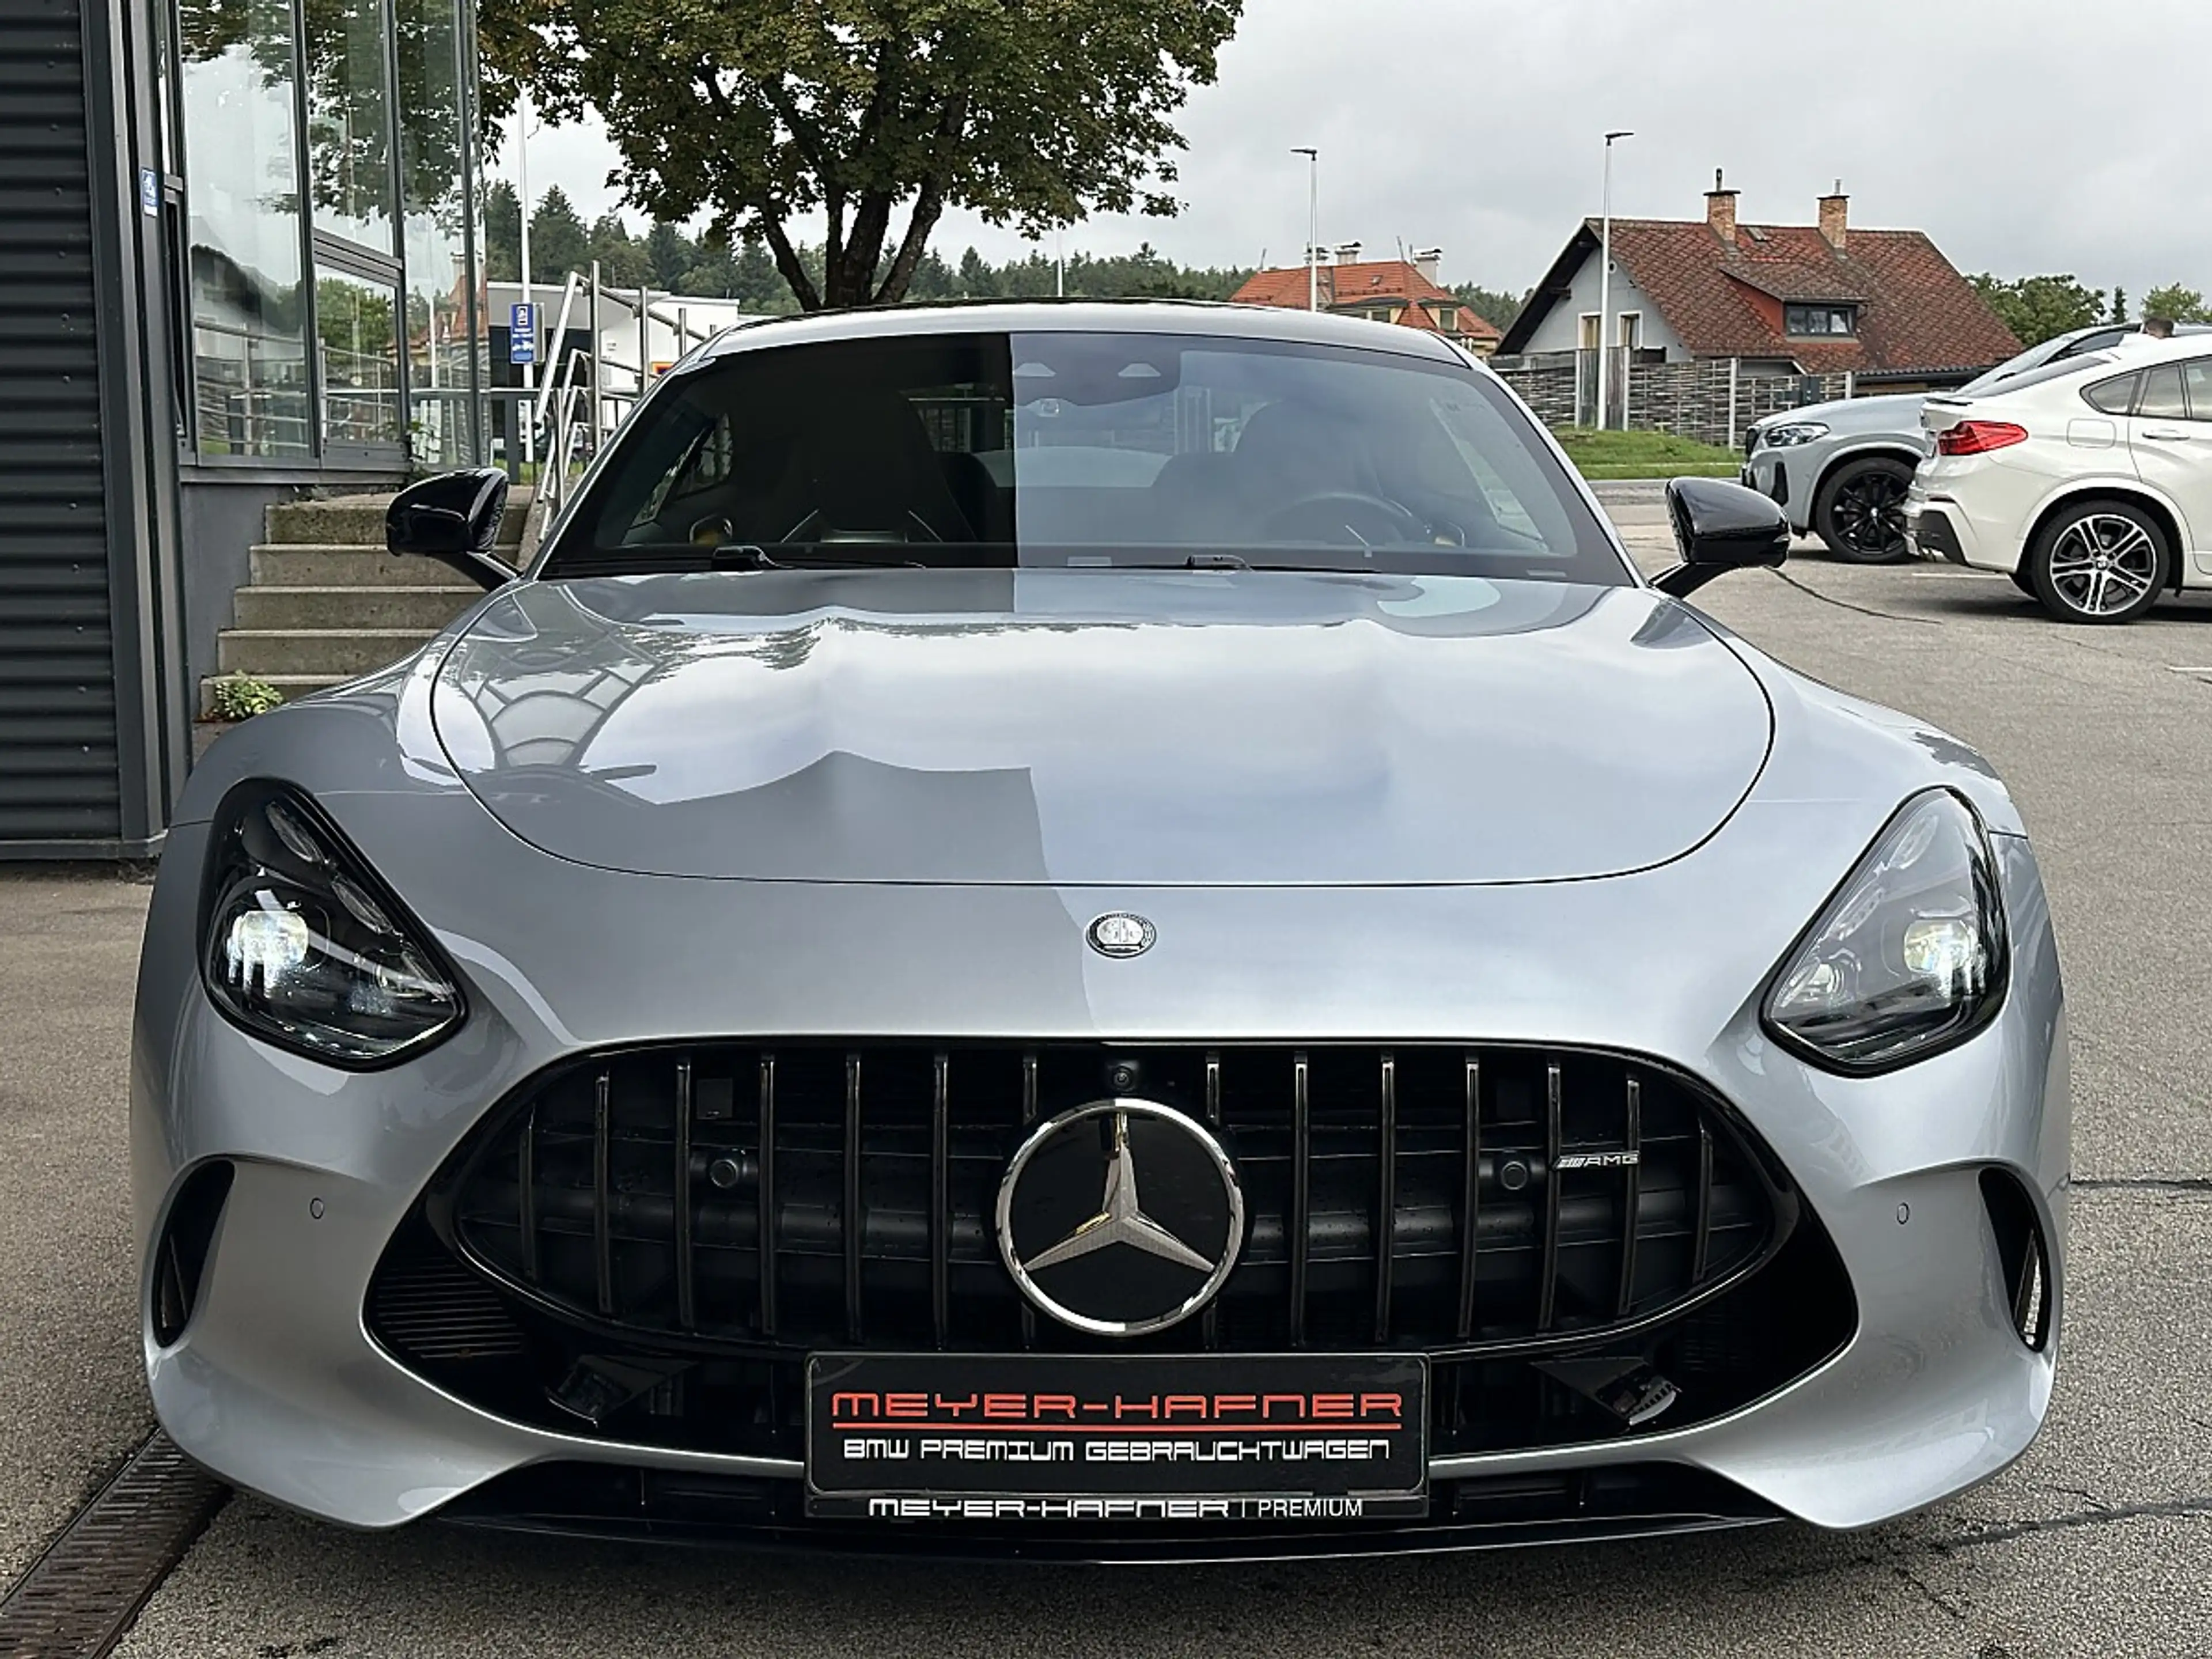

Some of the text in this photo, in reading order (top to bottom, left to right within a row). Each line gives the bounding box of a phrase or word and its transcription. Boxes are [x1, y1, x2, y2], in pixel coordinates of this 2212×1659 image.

[832, 1393, 1403, 1419] MEYER-HAFNER
[843, 1438, 1390, 1461] BMW PREMIUM GEBRAUCHTWAGEN
[868, 1498, 1363, 1518] MEYER-HAFNER PREMIUM
